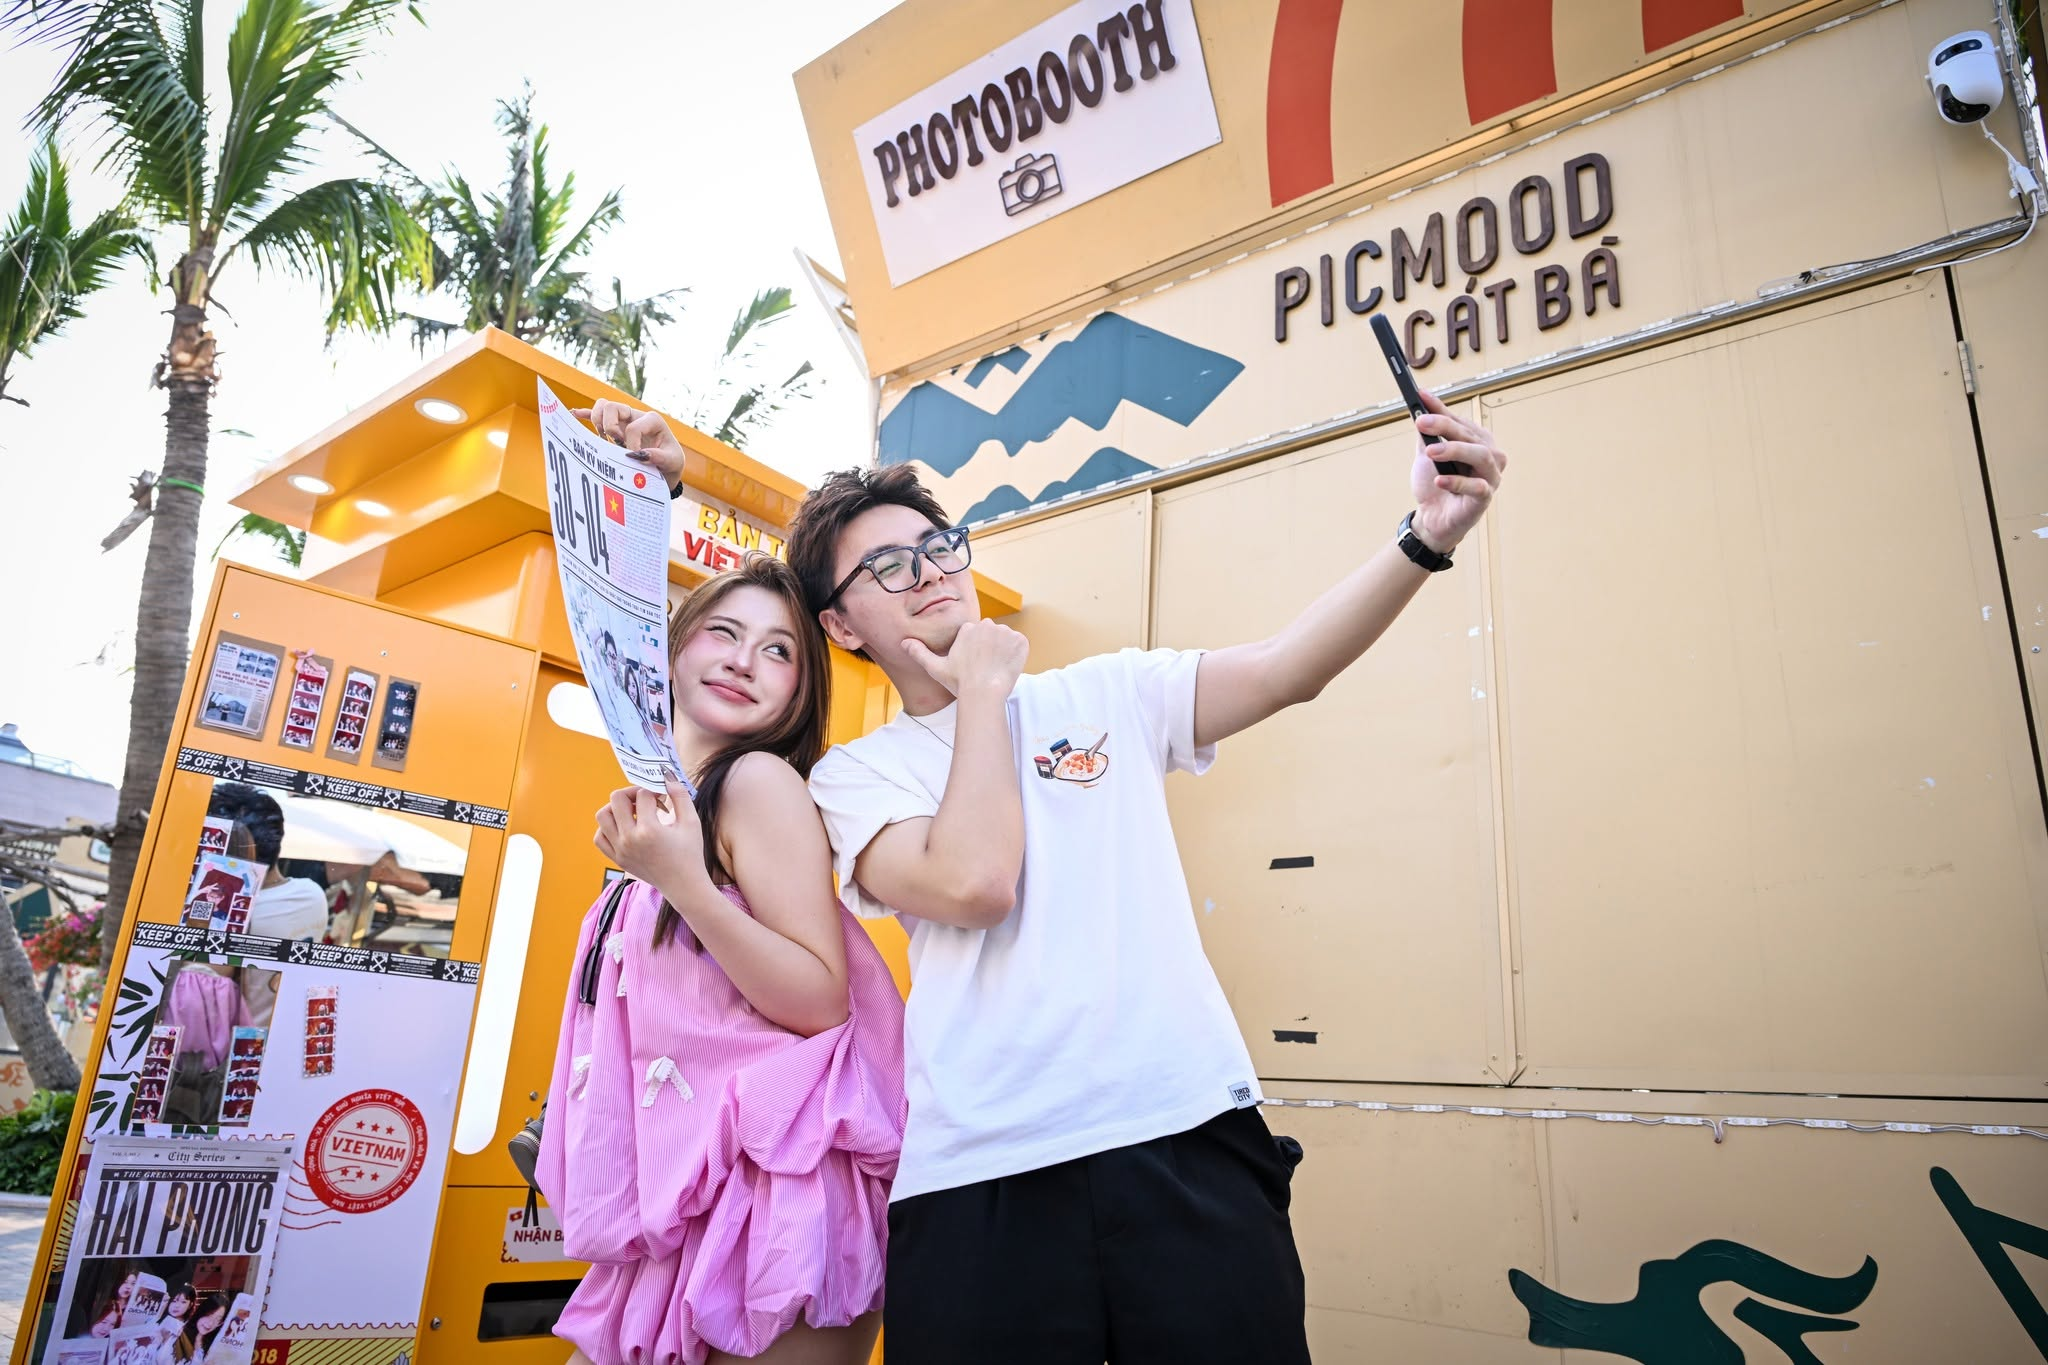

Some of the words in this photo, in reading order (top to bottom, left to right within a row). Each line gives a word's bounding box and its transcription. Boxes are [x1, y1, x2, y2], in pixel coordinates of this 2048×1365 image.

[873, 0, 1177, 208] PHOTOBOOTH
[1274, 152, 1614, 344] PICMOOD
[547, 440, 610, 576] 30-04
[698, 503, 762, 550] BẢN
[168, 1151, 190, 1164] City
[193, 1151, 226, 1162] Series
[332, 1136, 407, 1162] VIETNAM
[123, 1171, 142, 1179] THE
[143, 1171, 173, 1179] GREEN
[175, 1172, 205, 1180] JEWEL
[513, 1227, 552, 1245] NHẬN
[554, 1229, 564, 1242] B
